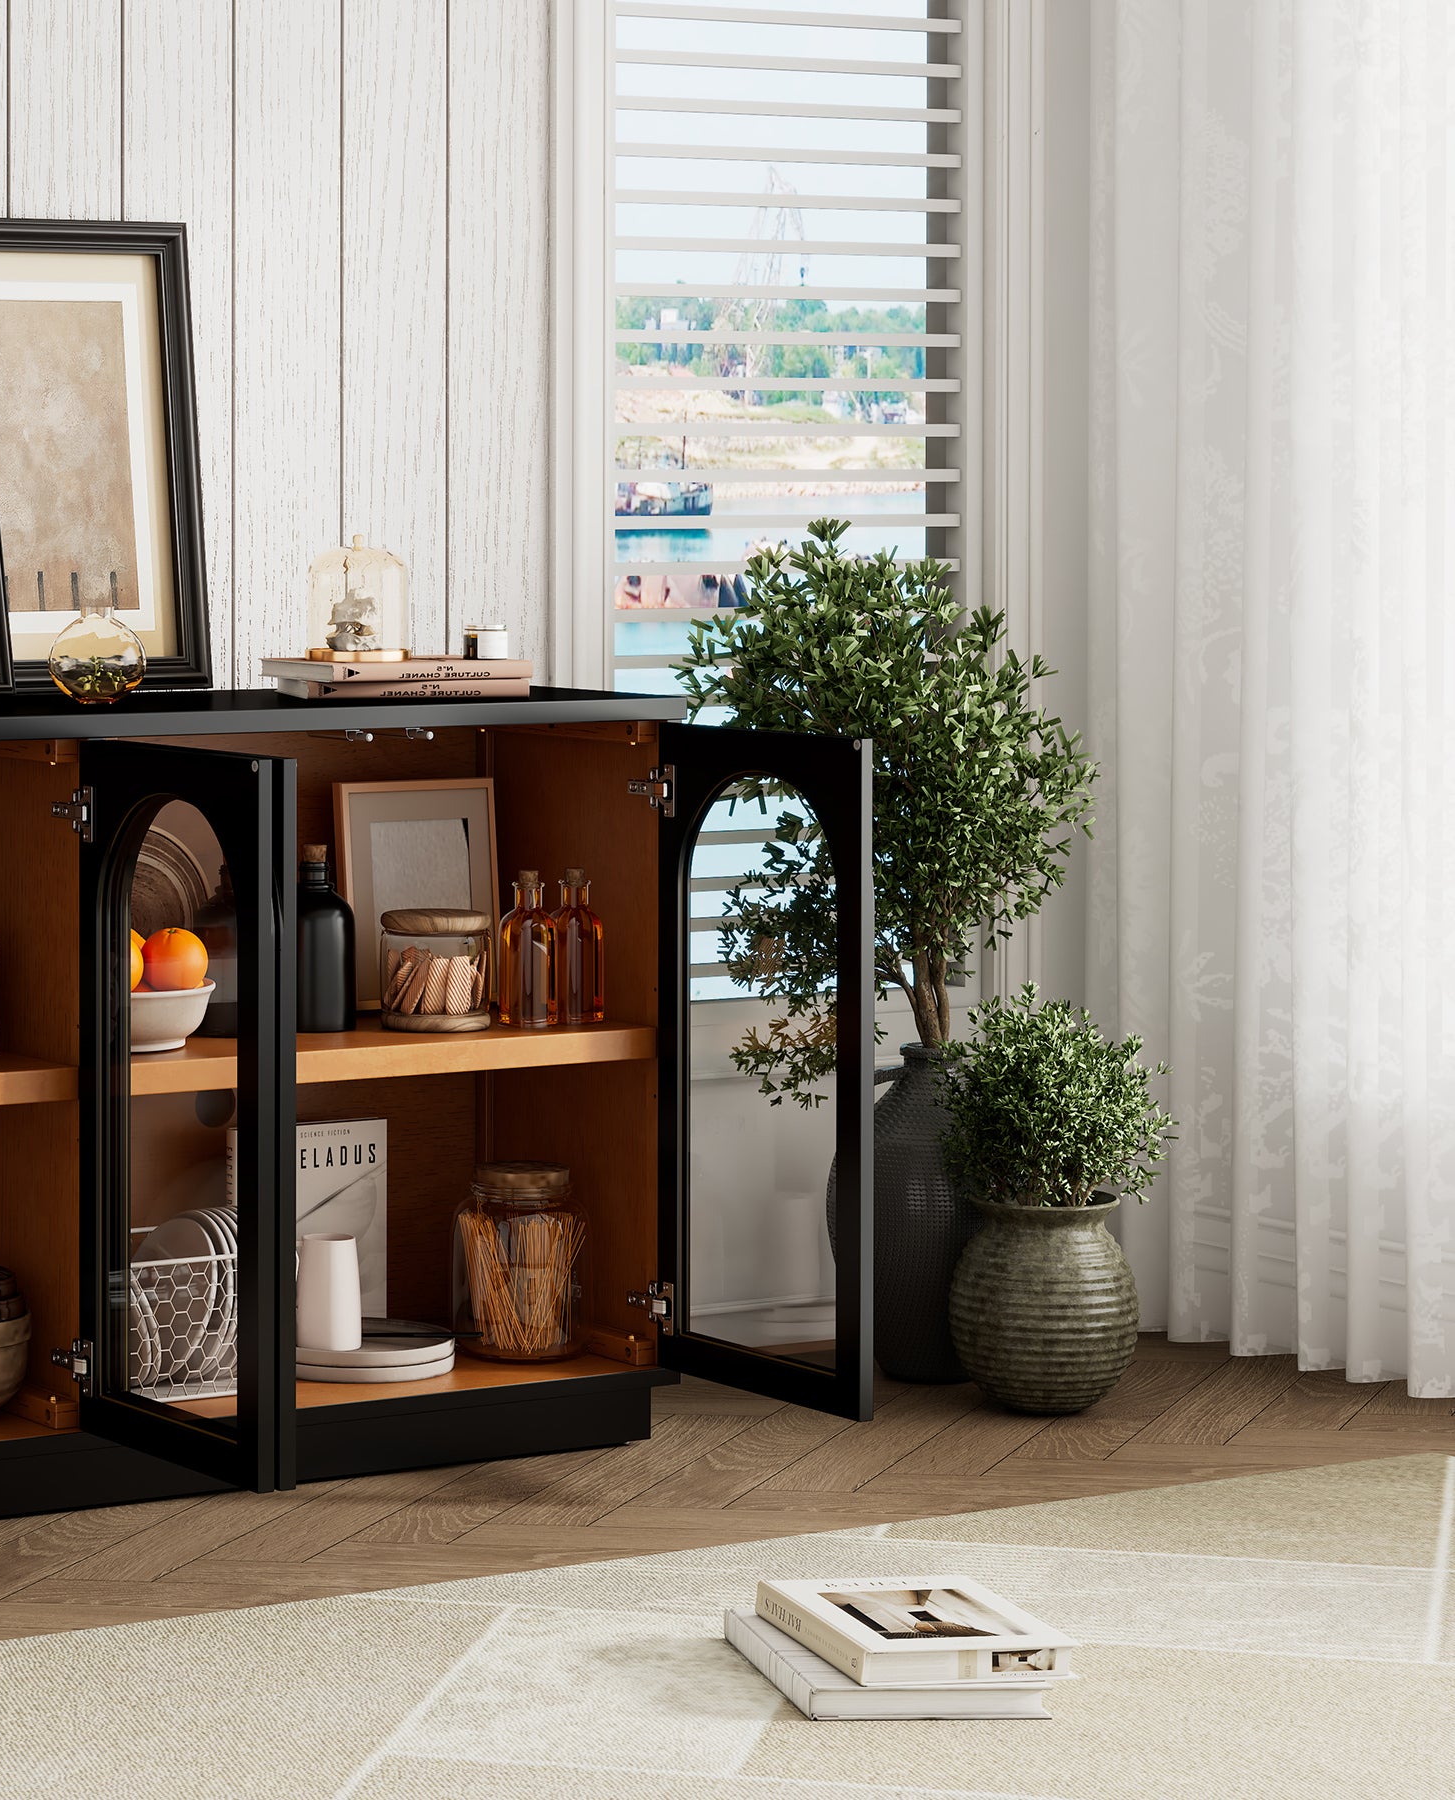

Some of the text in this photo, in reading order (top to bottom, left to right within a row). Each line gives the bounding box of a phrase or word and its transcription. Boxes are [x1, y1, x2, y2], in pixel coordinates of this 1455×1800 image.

[300, 1128, 351, 1139] SCIENCE FICTION
[300, 1143, 376, 1169] ELADUS
[764, 1598, 802, 1632] BAUHAUS
